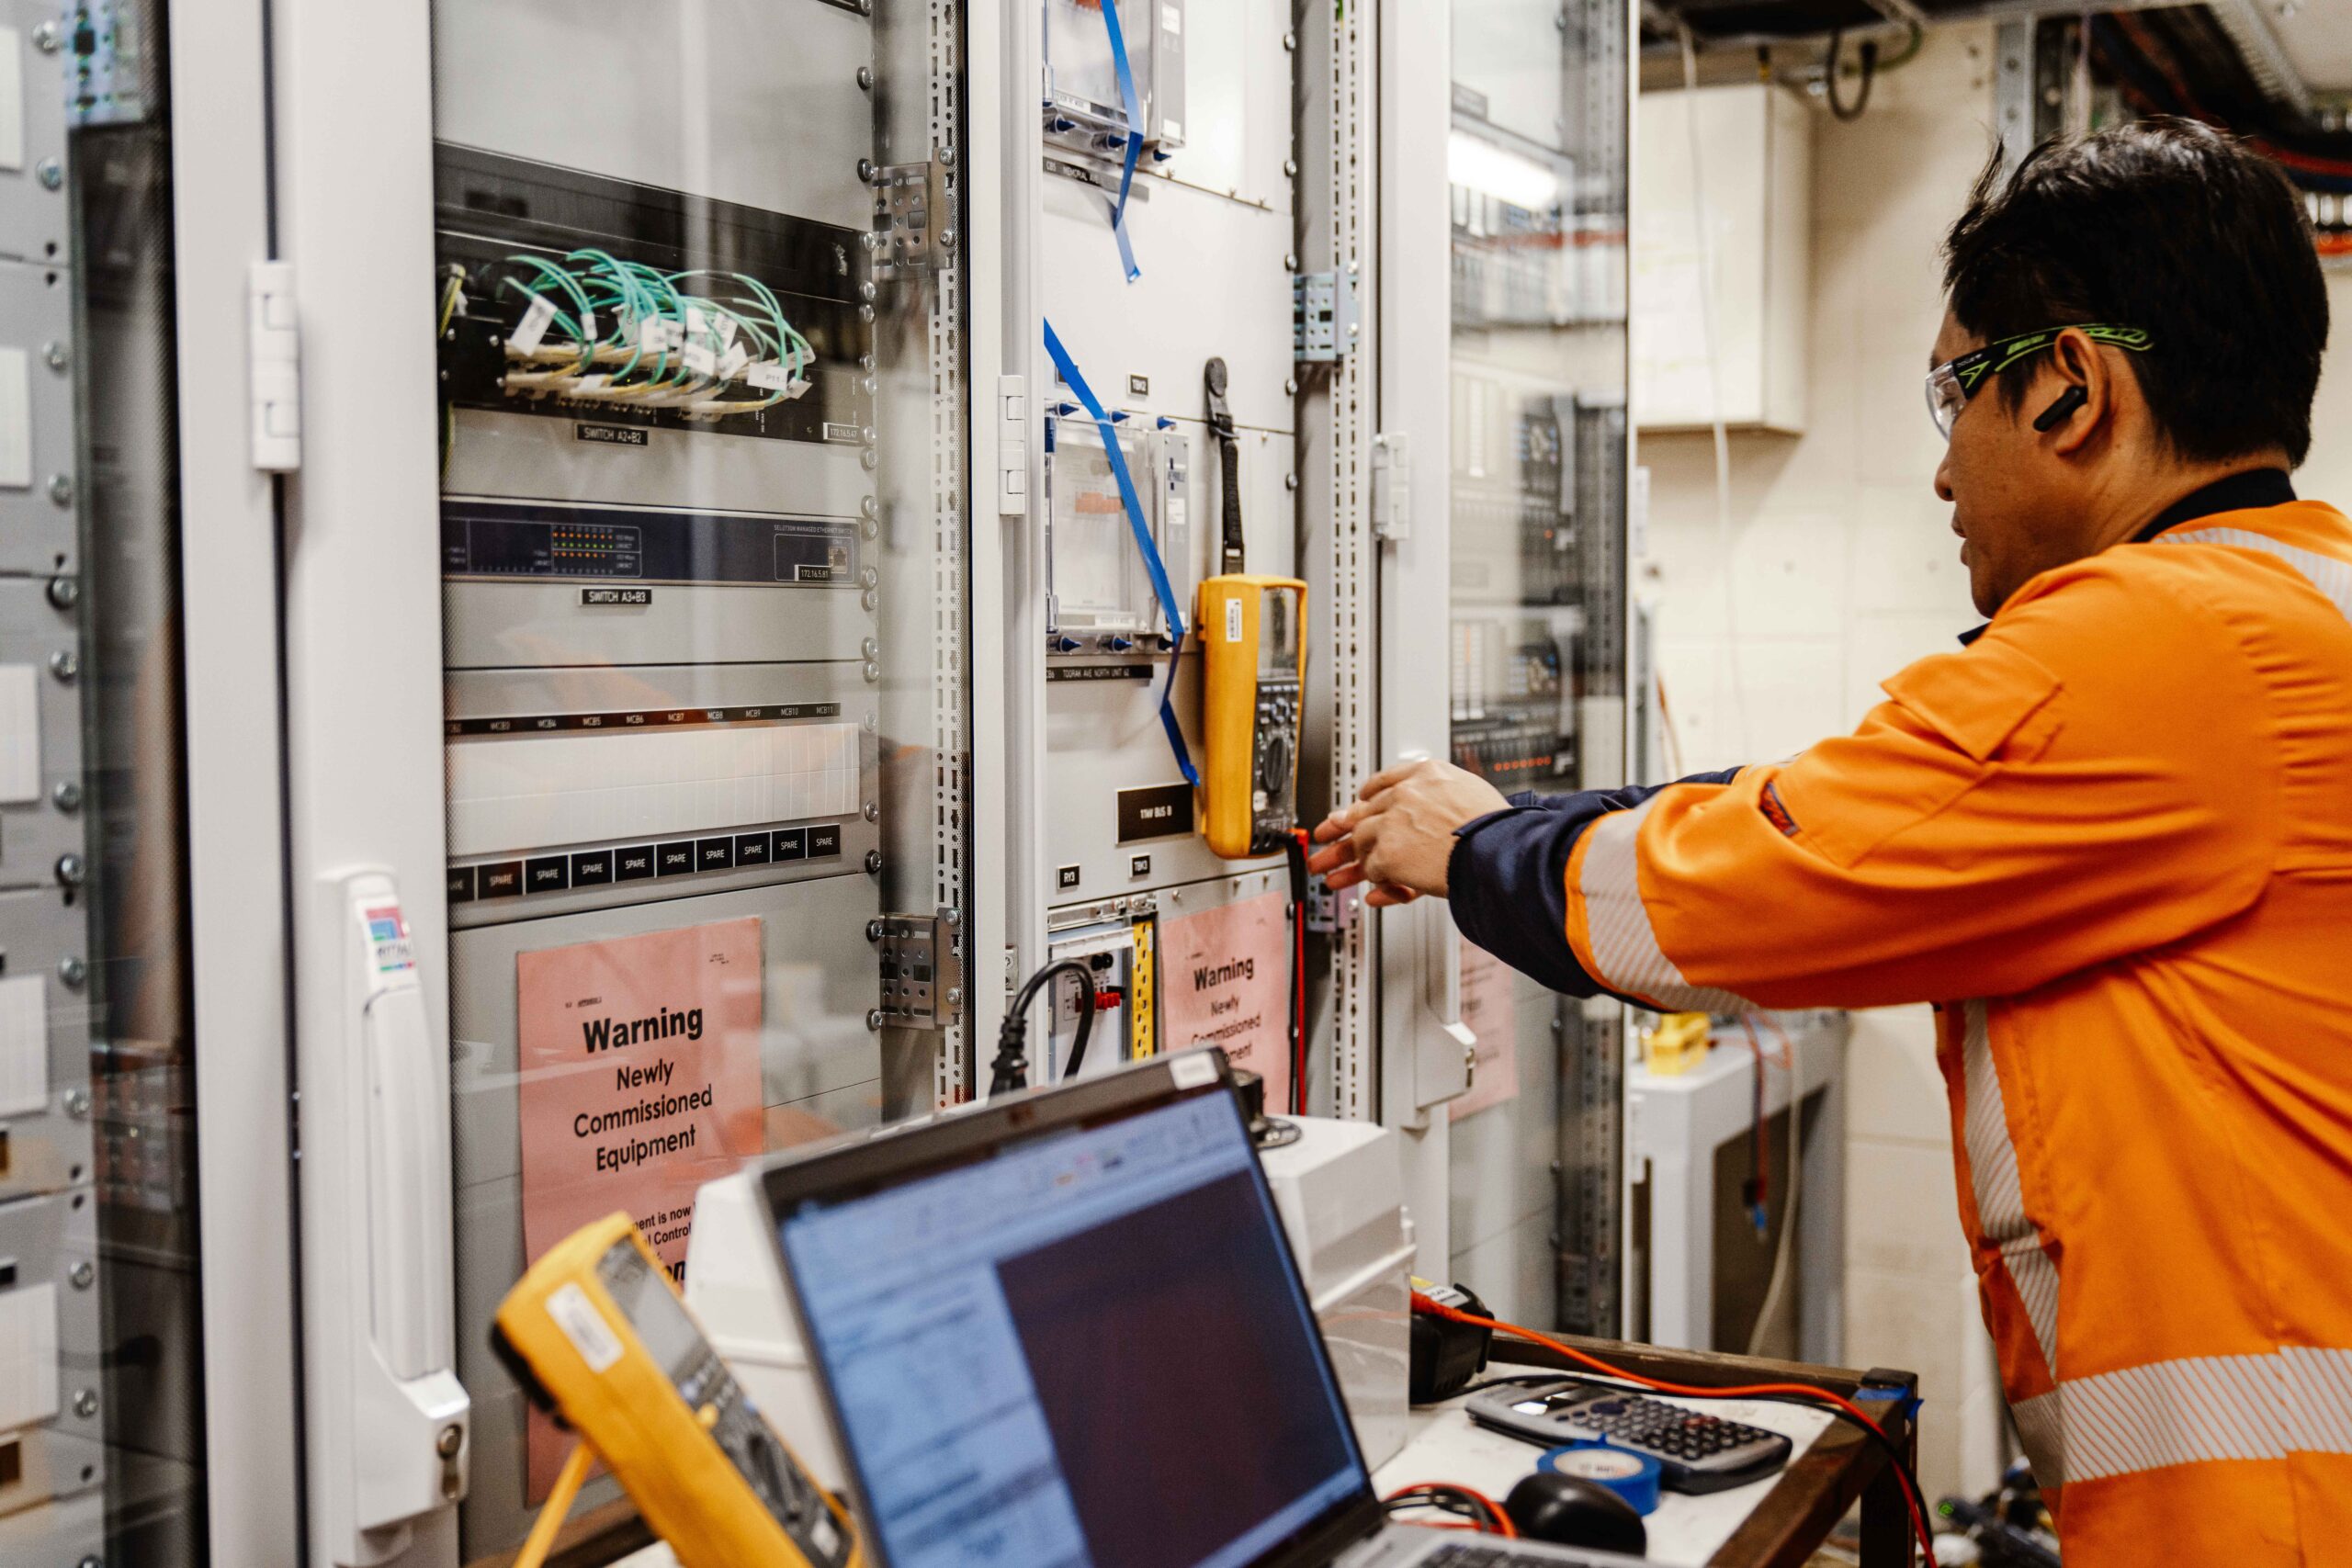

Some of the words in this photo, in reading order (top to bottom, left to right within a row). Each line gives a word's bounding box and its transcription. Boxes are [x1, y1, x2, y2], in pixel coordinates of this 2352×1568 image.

[583, 427, 615, 442] SWITCH
[616, 431, 642, 444] A2+B2
[588, 591, 619, 603] SWITCH
[621, 591, 647, 603] A3+B3
[1062, 669, 1082, 679] TOORAK
[582, 716, 602, 727] MCB5
[667, 713, 685, 722] MCB7
[707, 710, 724, 721] MCB8
[745, 708, 762, 718] MCB9
[781, 706, 799, 716] MCB10
[816, 705, 834, 715] MCB11
[489, 874, 514, 887] SPARE
[536, 868, 560, 881] SPARE
[582, 863, 604, 875] SPARE
[625, 857, 647, 870] SPARE
[666, 852, 687, 865] SPARE
[706, 849, 726, 861] SPARE
[744, 844, 763, 856] SPARE
[781, 840, 798, 852] SPARE
[816, 837, 833, 847] SPARE
[1064, 871, 1076, 884] RY3
[1193, 957, 1254, 992] Warning
[1211, 993, 1239, 1017] Newly
[582, 1007, 703, 1054] Warning
[616, 1057, 674, 1091] Newly
[574, 1083, 712, 1138] Commissioned
[596, 1123, 696, 1172] Equipment
[658, 1212, 667, 1225] is
[670, 1205, 692, 1222] now
